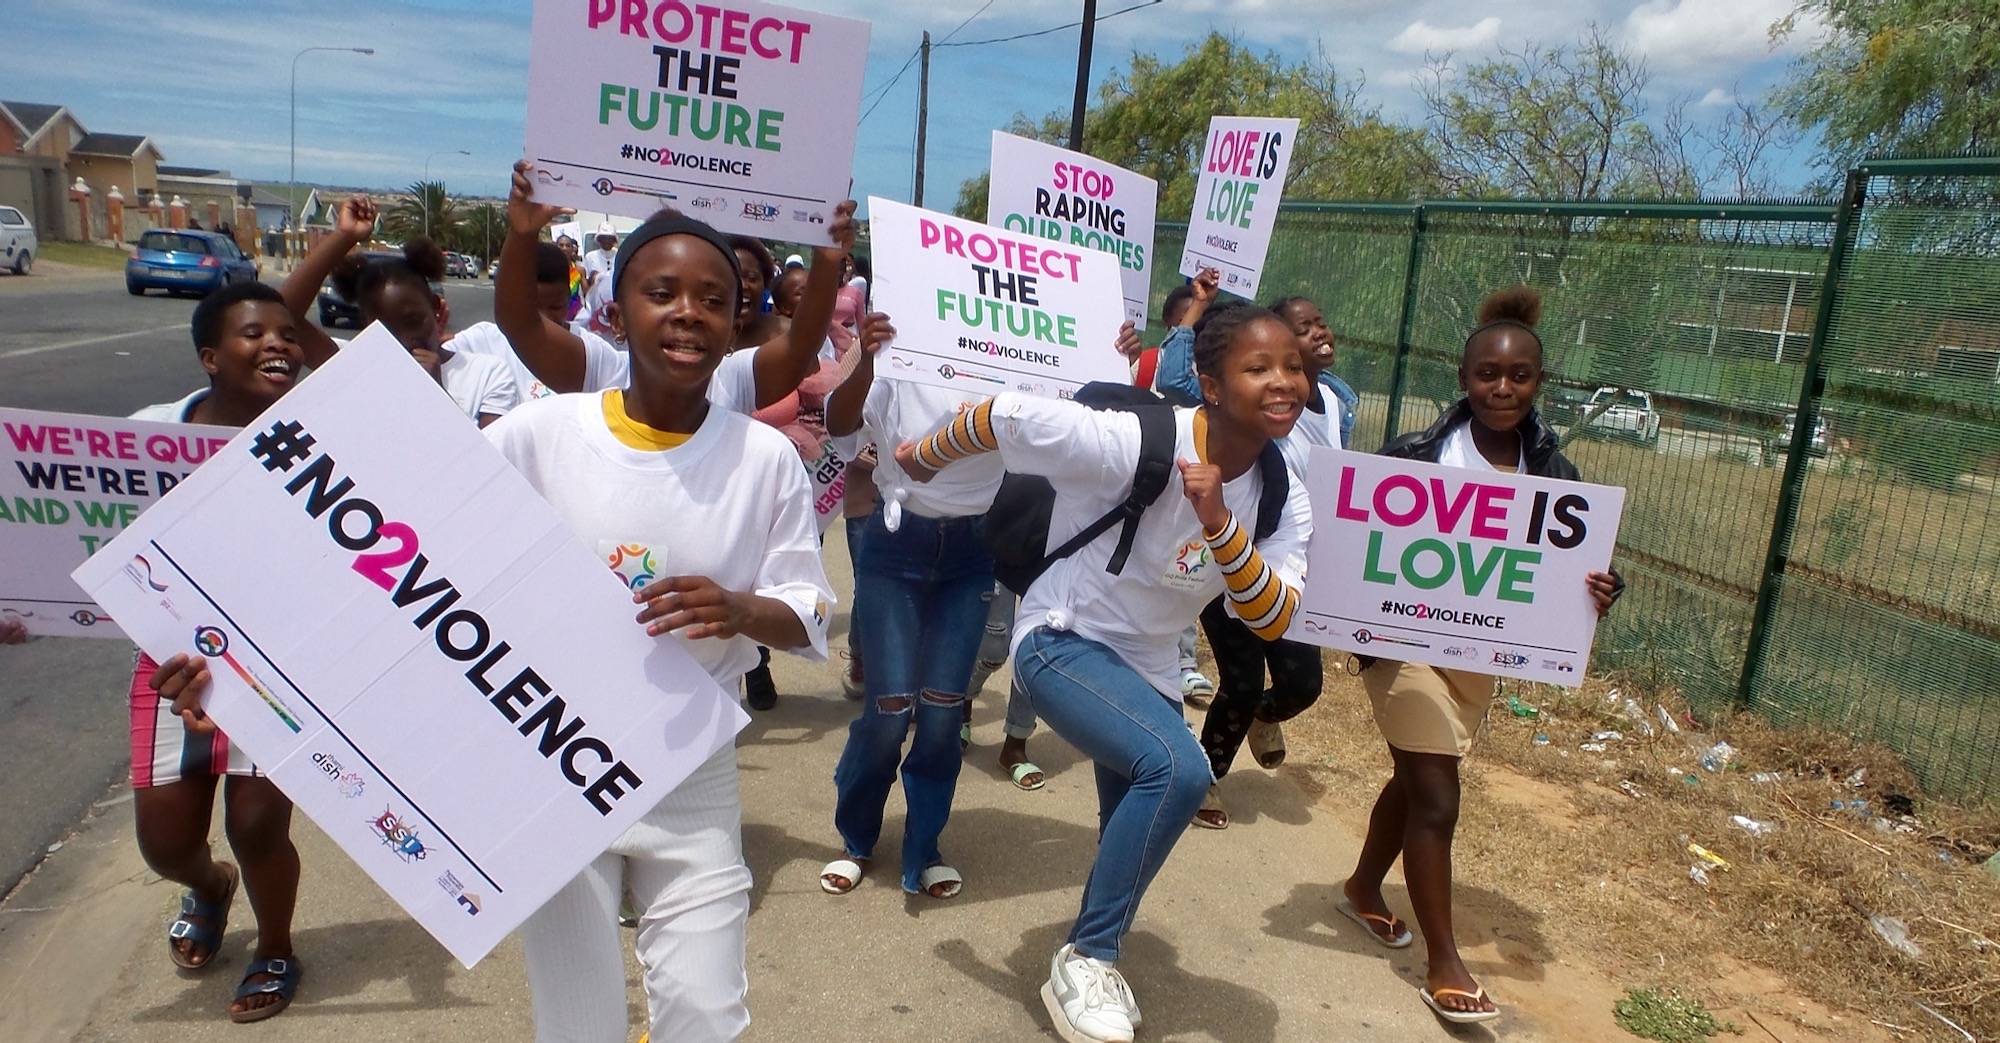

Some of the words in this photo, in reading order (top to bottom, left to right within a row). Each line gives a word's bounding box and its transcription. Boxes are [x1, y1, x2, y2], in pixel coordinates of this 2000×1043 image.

[588, 0, 811, 63] PROTECT
[653, 45, 740, 99] THE
[599, 83, 784, 152] FUTURE
[621, 144, 752, 177] #NO2VIOLENCE
[1208, 130, 1260, 177] LOVE
[1256, 131, 1282, 180] IS
[1053, 161, 1114, 200] STOP
[1206, 178, 1259, 229] LOVE
[1035, 187, 1126, 237] RAPING
[920, 218, 1082, 283] PROTECT
[1070, 225, 1144, 272] BODIES
[972, 264, 1039, 306] THE
[936, 289, 1078, 348] FUTURE
[957, 336, 1060, 368] #NO2VIOLENCE
[3, 422, 139, 460] WE'RE
[146, 434, 229, 464] QUE
[15, 460, 149, 497] WE'RE
[817, 451, 845, 484] SED
[0, 495, 70, 525] AND
[1336, 466, 1516, 541] LOVE
[1526, 490, 1590, 549] IS
[1363, 530, 1542, 604] LOVE
[249, 420, 644, 817] #NO2VIOLENCE
[1380, 600, 1506, 630] #NO2VIOLENCE
[312, 752, 342, 780] dish
